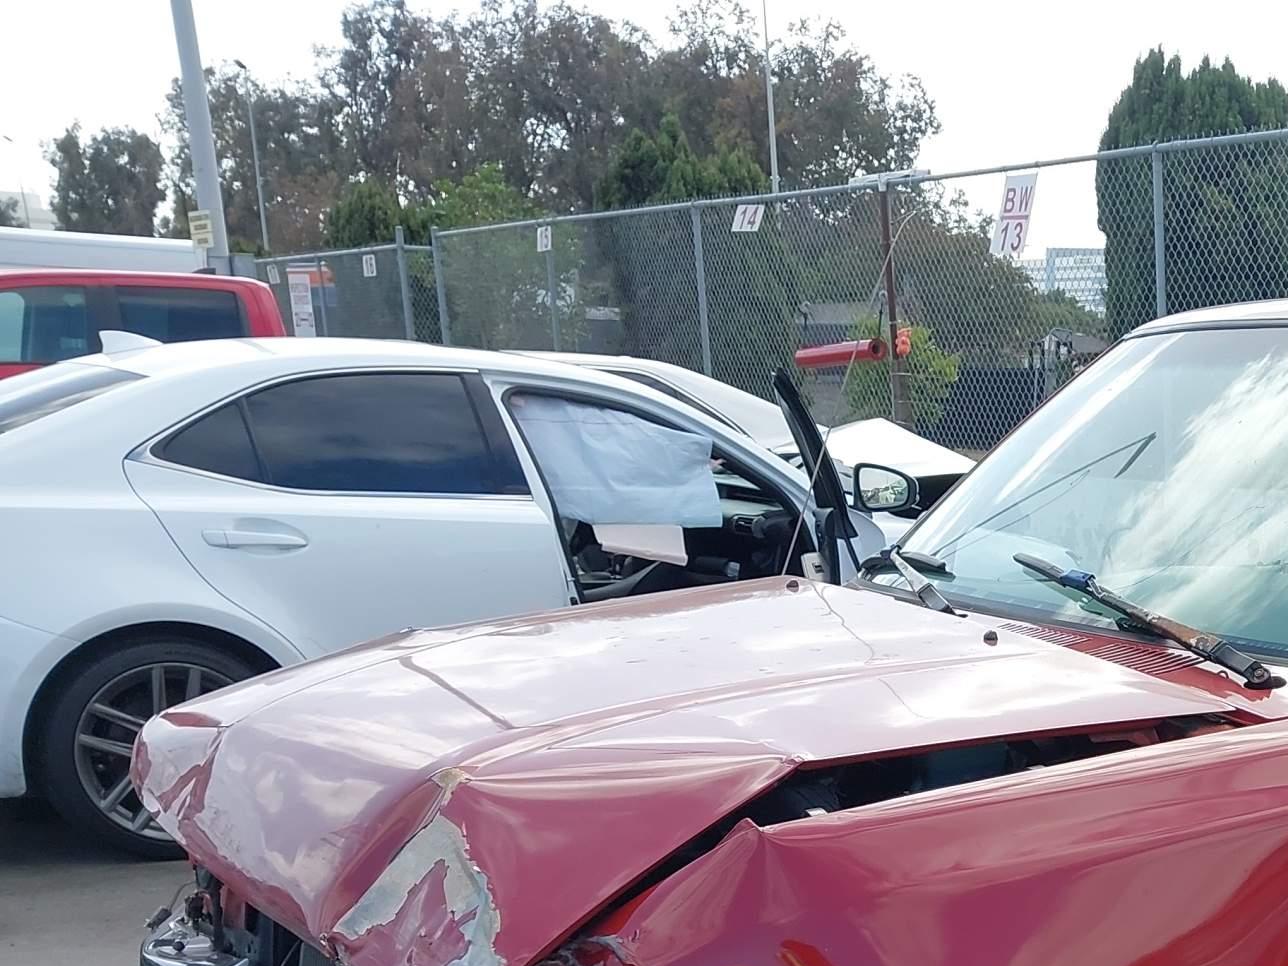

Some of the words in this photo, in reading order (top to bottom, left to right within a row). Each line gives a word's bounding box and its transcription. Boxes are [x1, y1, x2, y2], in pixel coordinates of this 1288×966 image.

[1003, 186, 1033, 213] BW
[739, 205, 760, 231] 14
[1001, 221, 1023, 251] 13
